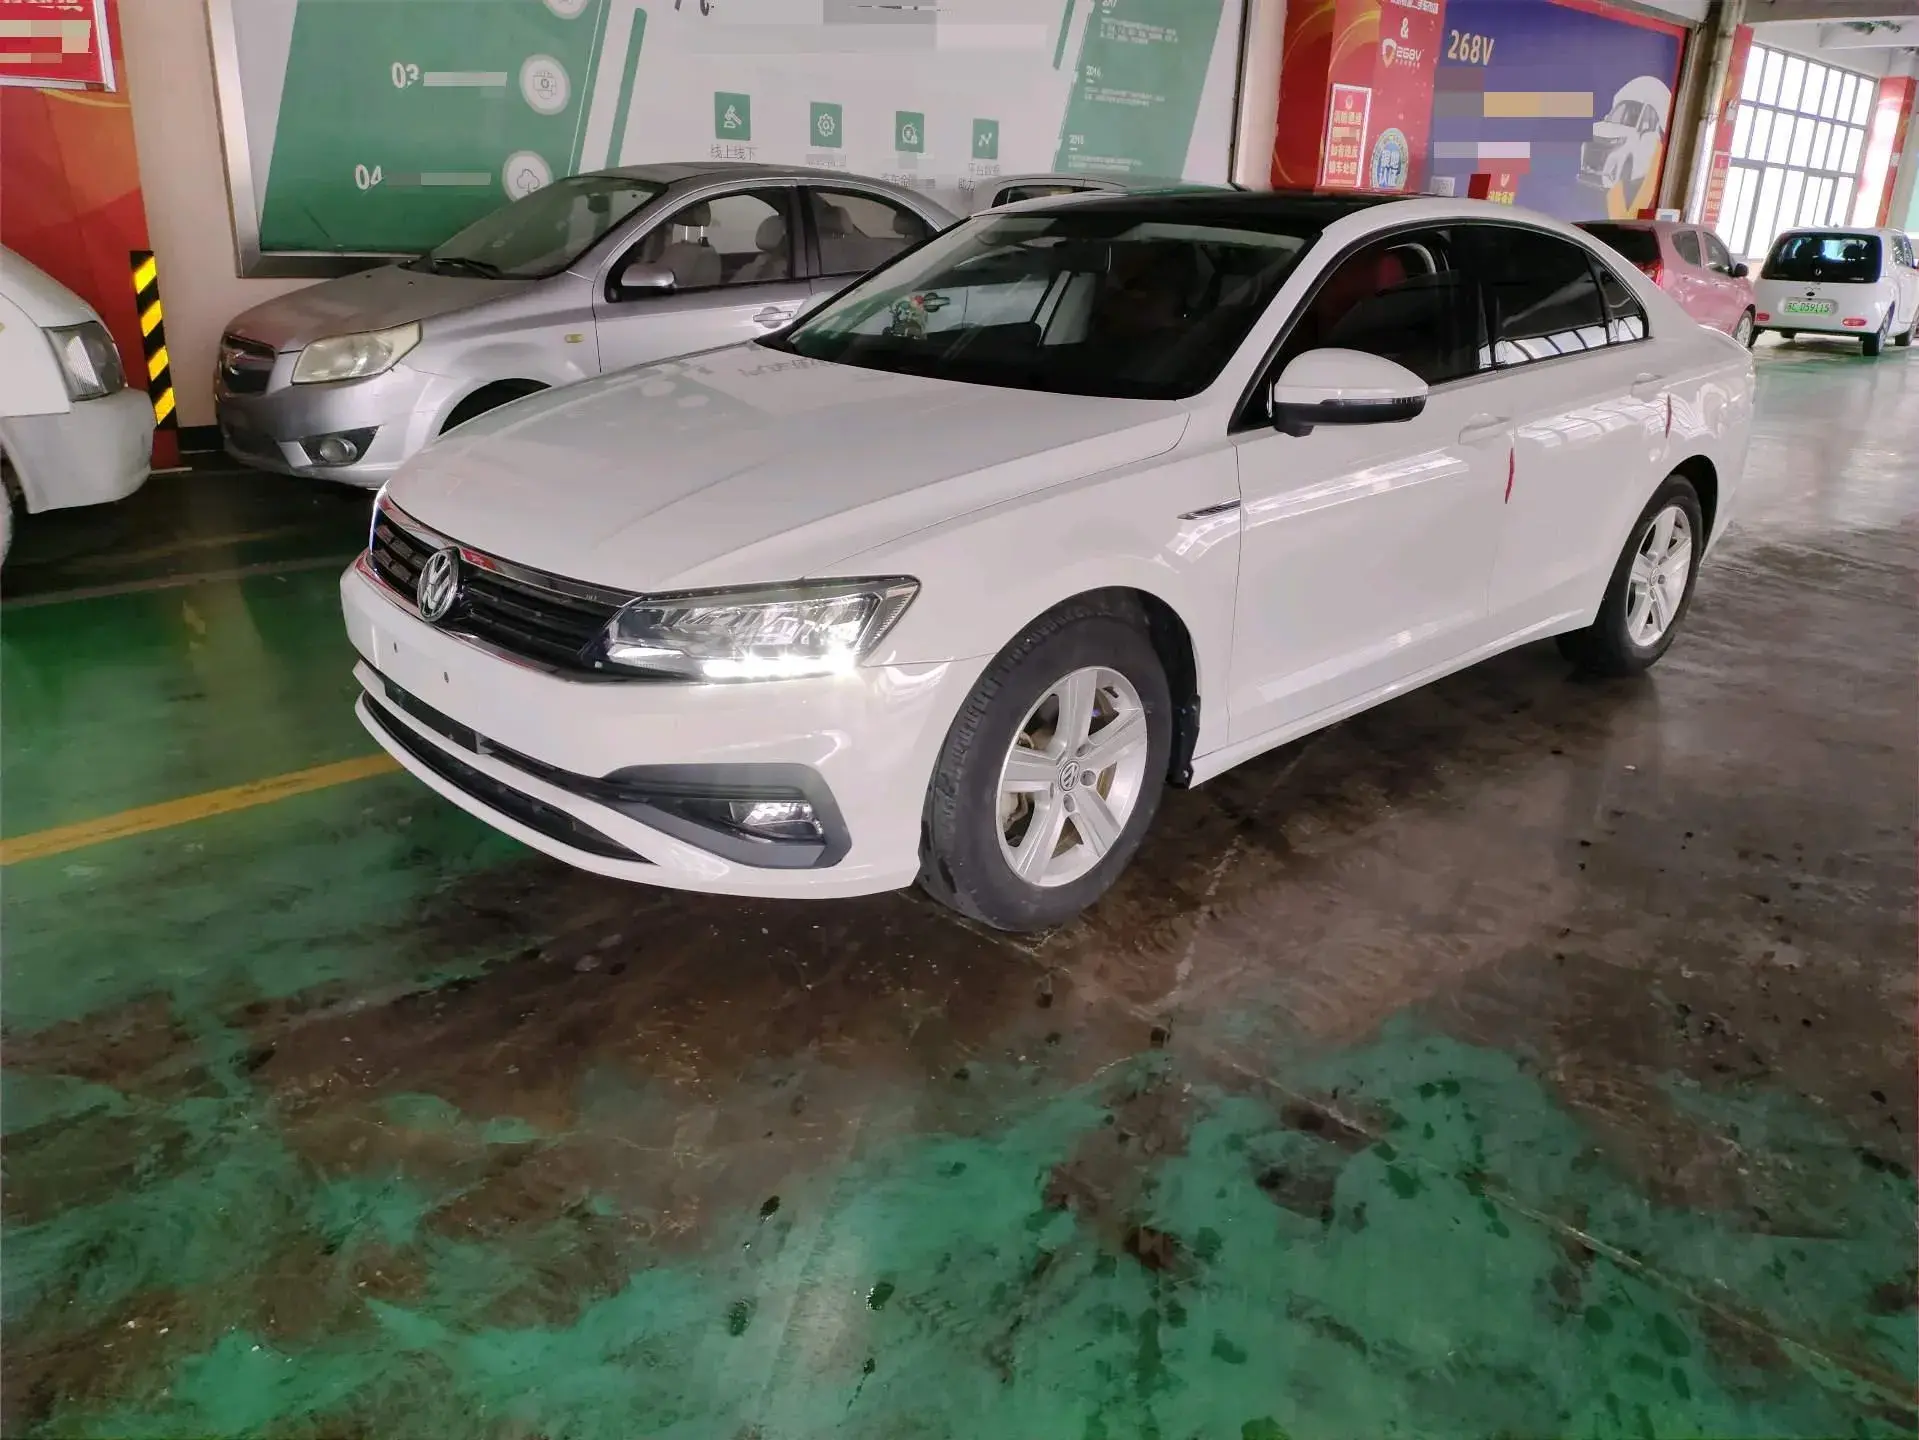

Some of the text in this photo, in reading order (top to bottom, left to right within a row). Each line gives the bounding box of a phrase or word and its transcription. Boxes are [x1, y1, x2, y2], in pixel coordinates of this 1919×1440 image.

[1400, 17, 1409, 39] &
[1396, 46, 1422, 61] 268V
[1447, 29, 1495, 66] 268V
[391, 62, 420, 89] 03
[710, 144, 758, 161] 线上线下
[355, 163, 384, 190] 04
